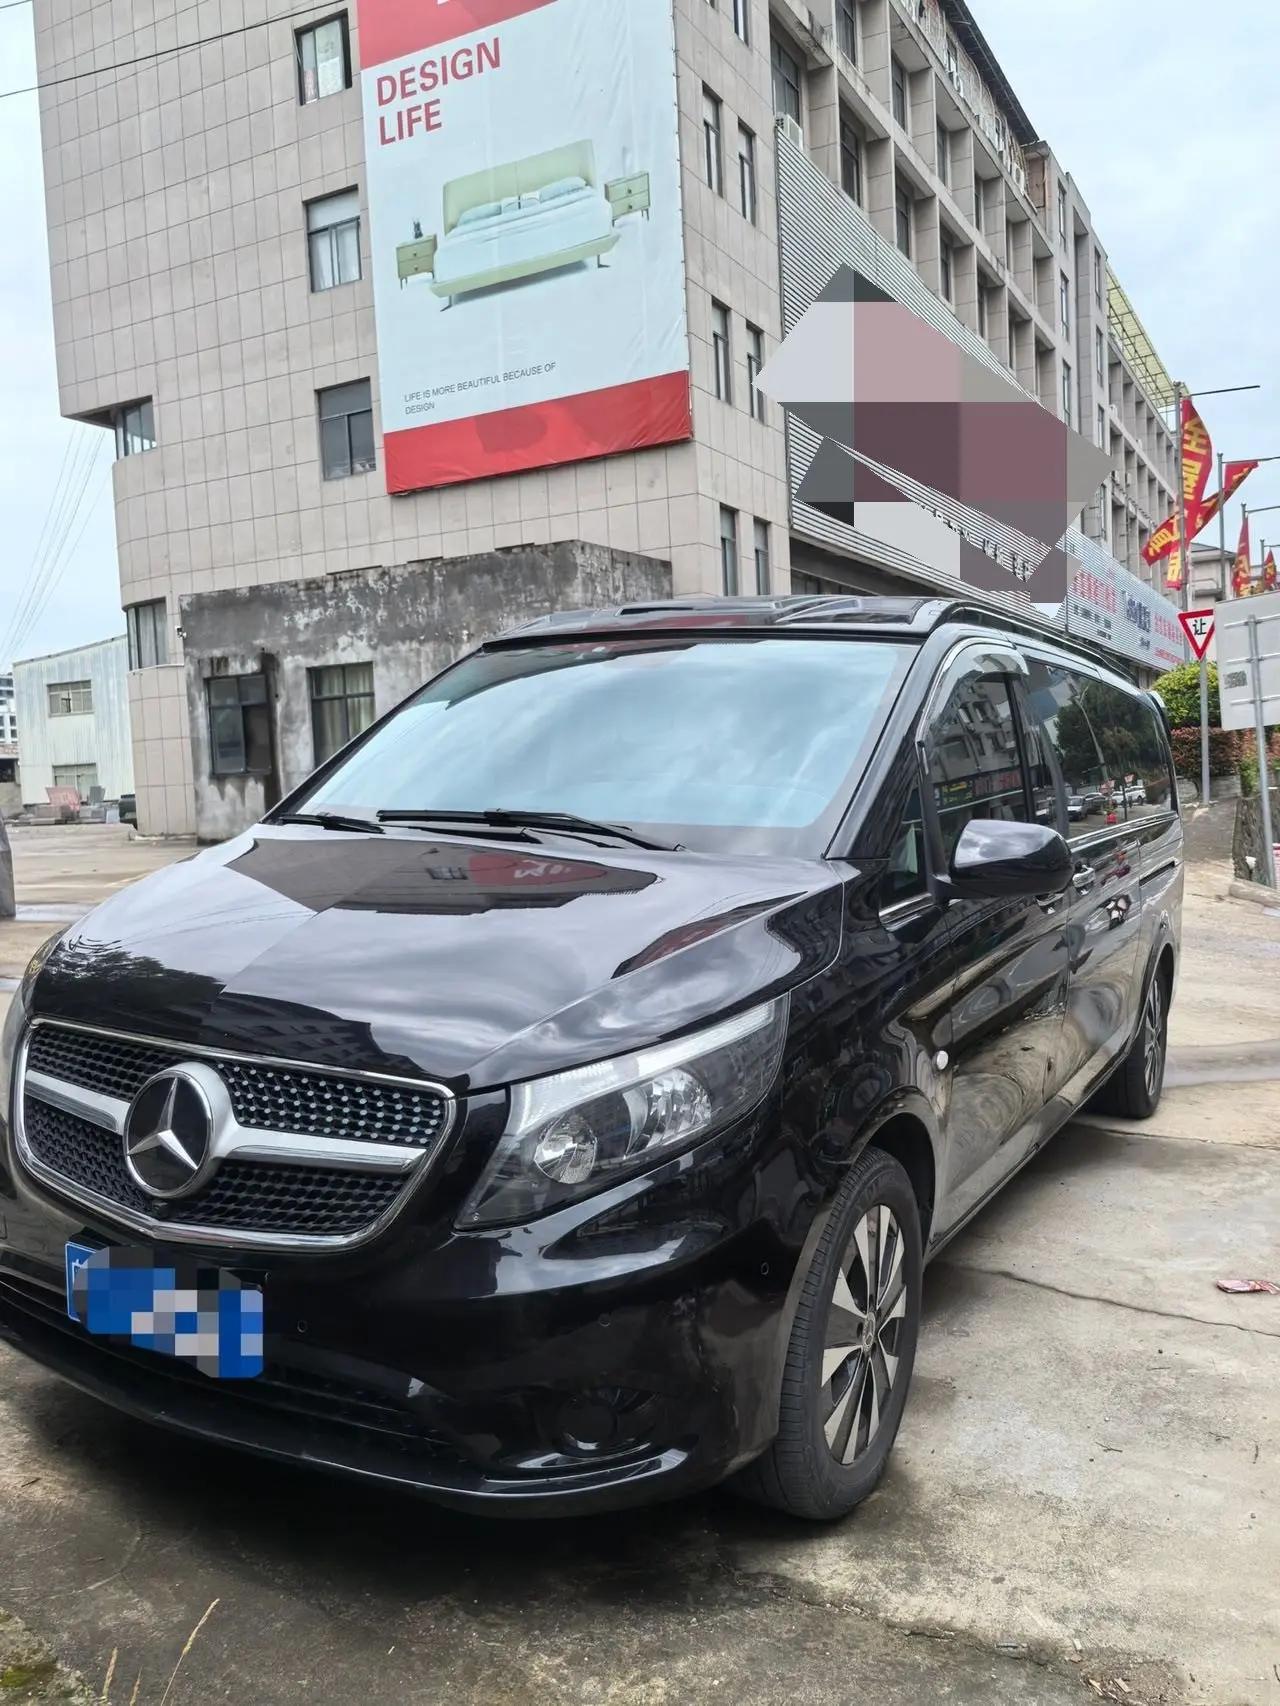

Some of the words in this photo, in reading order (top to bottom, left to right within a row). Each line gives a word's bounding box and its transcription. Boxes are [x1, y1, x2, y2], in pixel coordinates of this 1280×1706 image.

[377, 37, 500, 106] DESIGN
[380, 99, 442, 145] LIFE
[404, 391, 422, 403] LIFE
[422, 389, 431, 399] IS
[432, 384, 455, 397] MORE
[457, 375, 501, 391] BEAUTIFUL
[503, 365, 543, 381] BECAUSE
[544, 362, 556, 372] OF
[405, 402, 435, 414] DESIGN
[1192, 617, 1207, 636] 让
